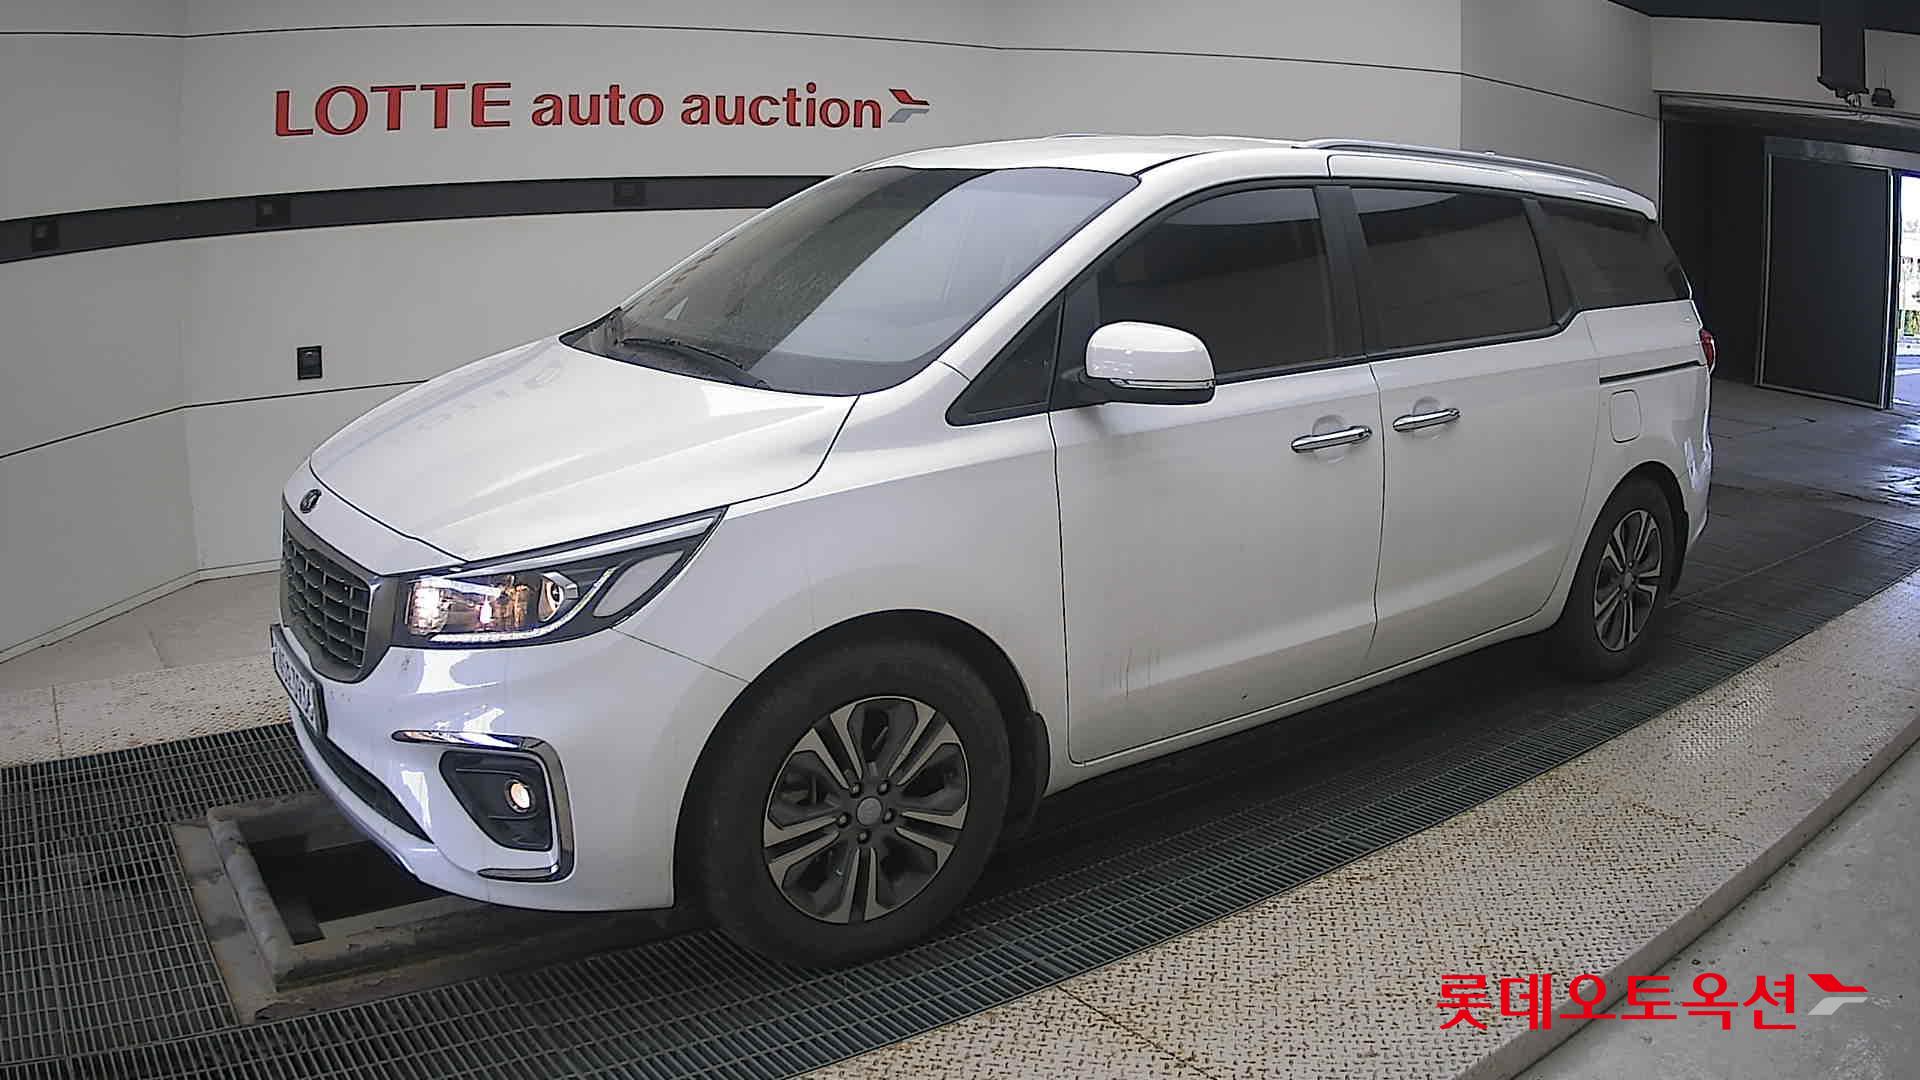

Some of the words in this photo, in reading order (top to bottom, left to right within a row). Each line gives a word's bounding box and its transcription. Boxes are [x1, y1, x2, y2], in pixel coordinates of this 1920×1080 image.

[275, 82, 512, 137] LOTTE
[531, 84, 664, 127] auto
[680, 82, 882, 129] auction
